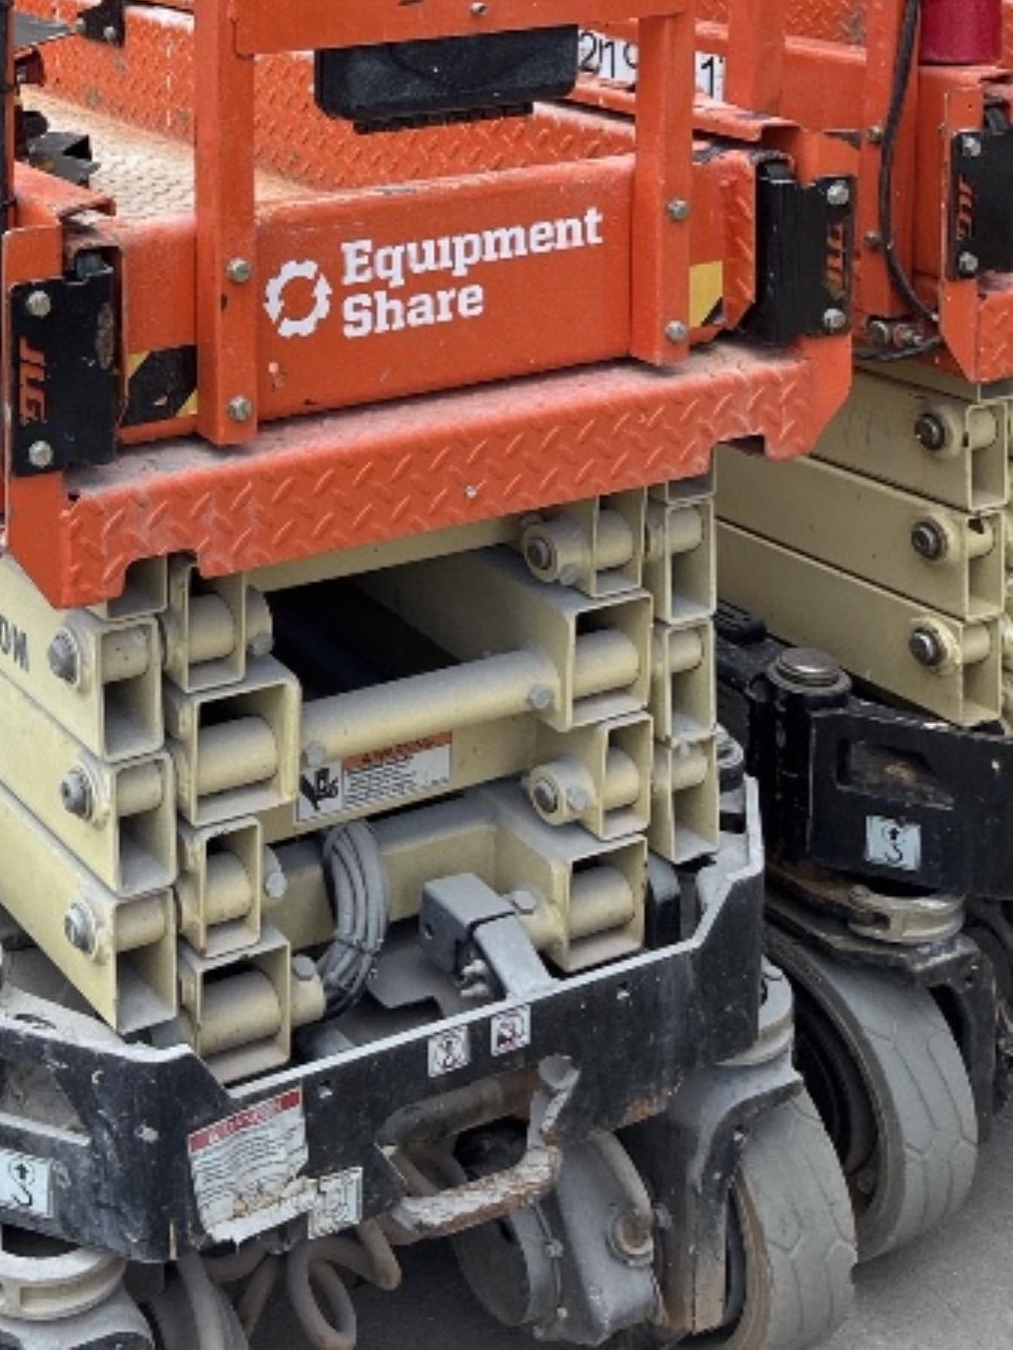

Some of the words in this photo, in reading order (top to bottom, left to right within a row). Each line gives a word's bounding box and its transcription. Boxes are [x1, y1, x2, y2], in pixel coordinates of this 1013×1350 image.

[340, 206, 604, 287] Equipment
[342, 284, 484, 338] Share
[19, 333, 47, 426] JLG
